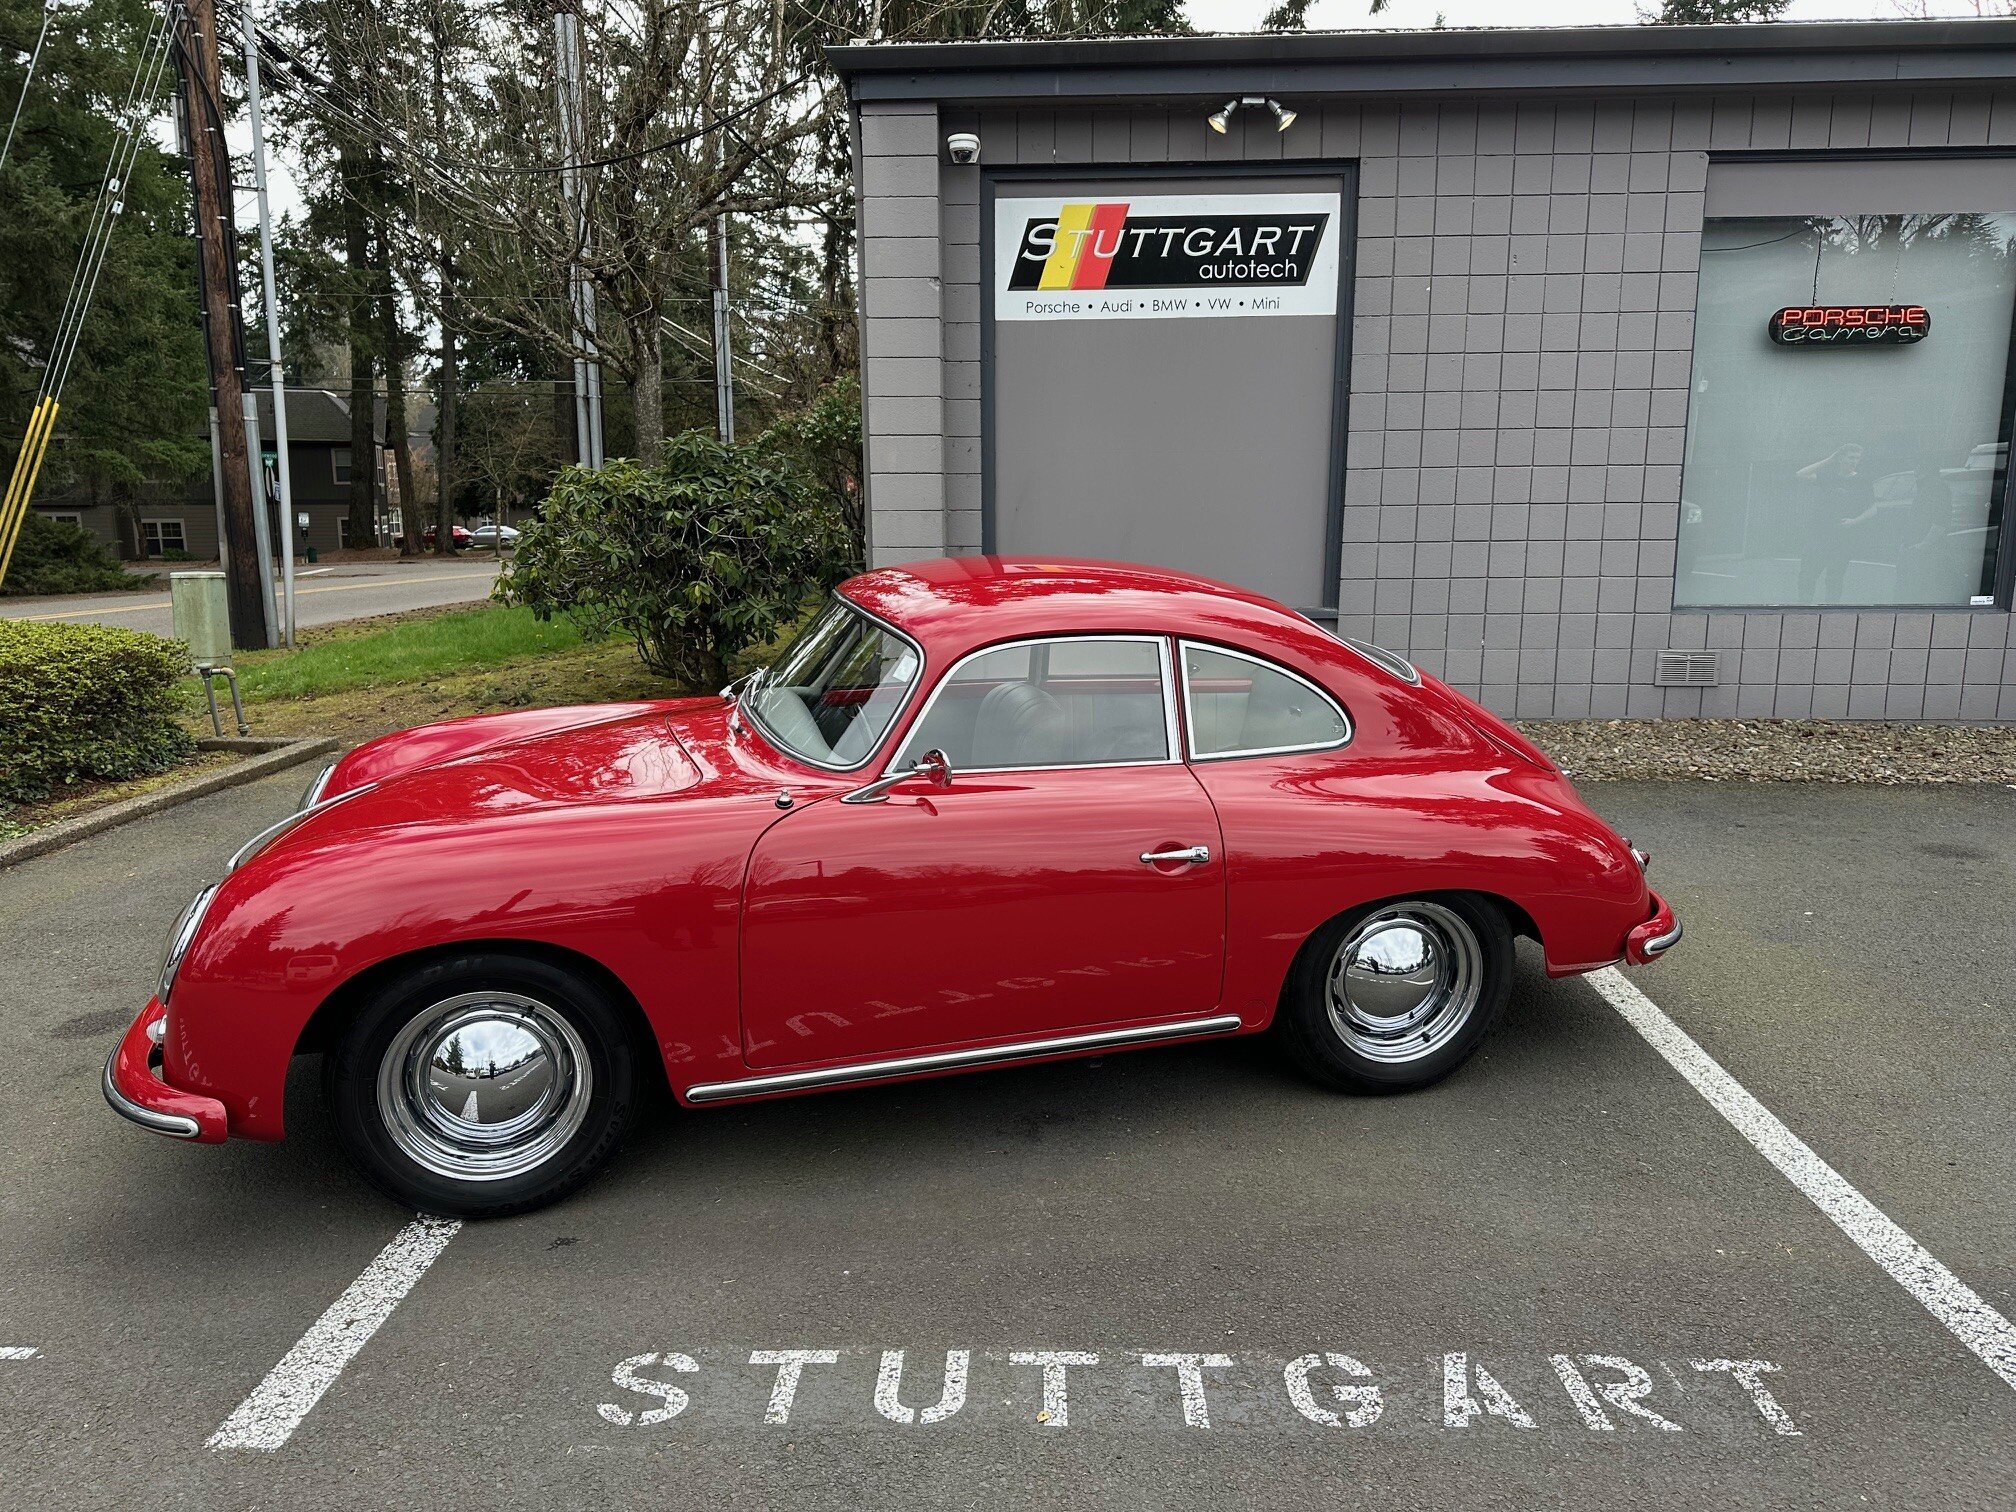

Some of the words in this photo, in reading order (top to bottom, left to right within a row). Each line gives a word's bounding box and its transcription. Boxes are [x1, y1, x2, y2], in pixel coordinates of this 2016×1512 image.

[1021, 223, 1316, 261] STUTTGART
[1199, 258, 1298, 279] autotech
[1026, 301, 1080, 314] Porsche
[1100, 299, 1133, 313] Audi
[1153, 299, 1187, 312] BMW
[1207, 298, 1232, 310] VW
[1252, 297, 1280, 310] Mini
[1782, 308, 1926, 326] PORSCHE
[1782, 325, 1925, 342] Carrera
[596, 1349, 1803, 1436] STUTTGART
